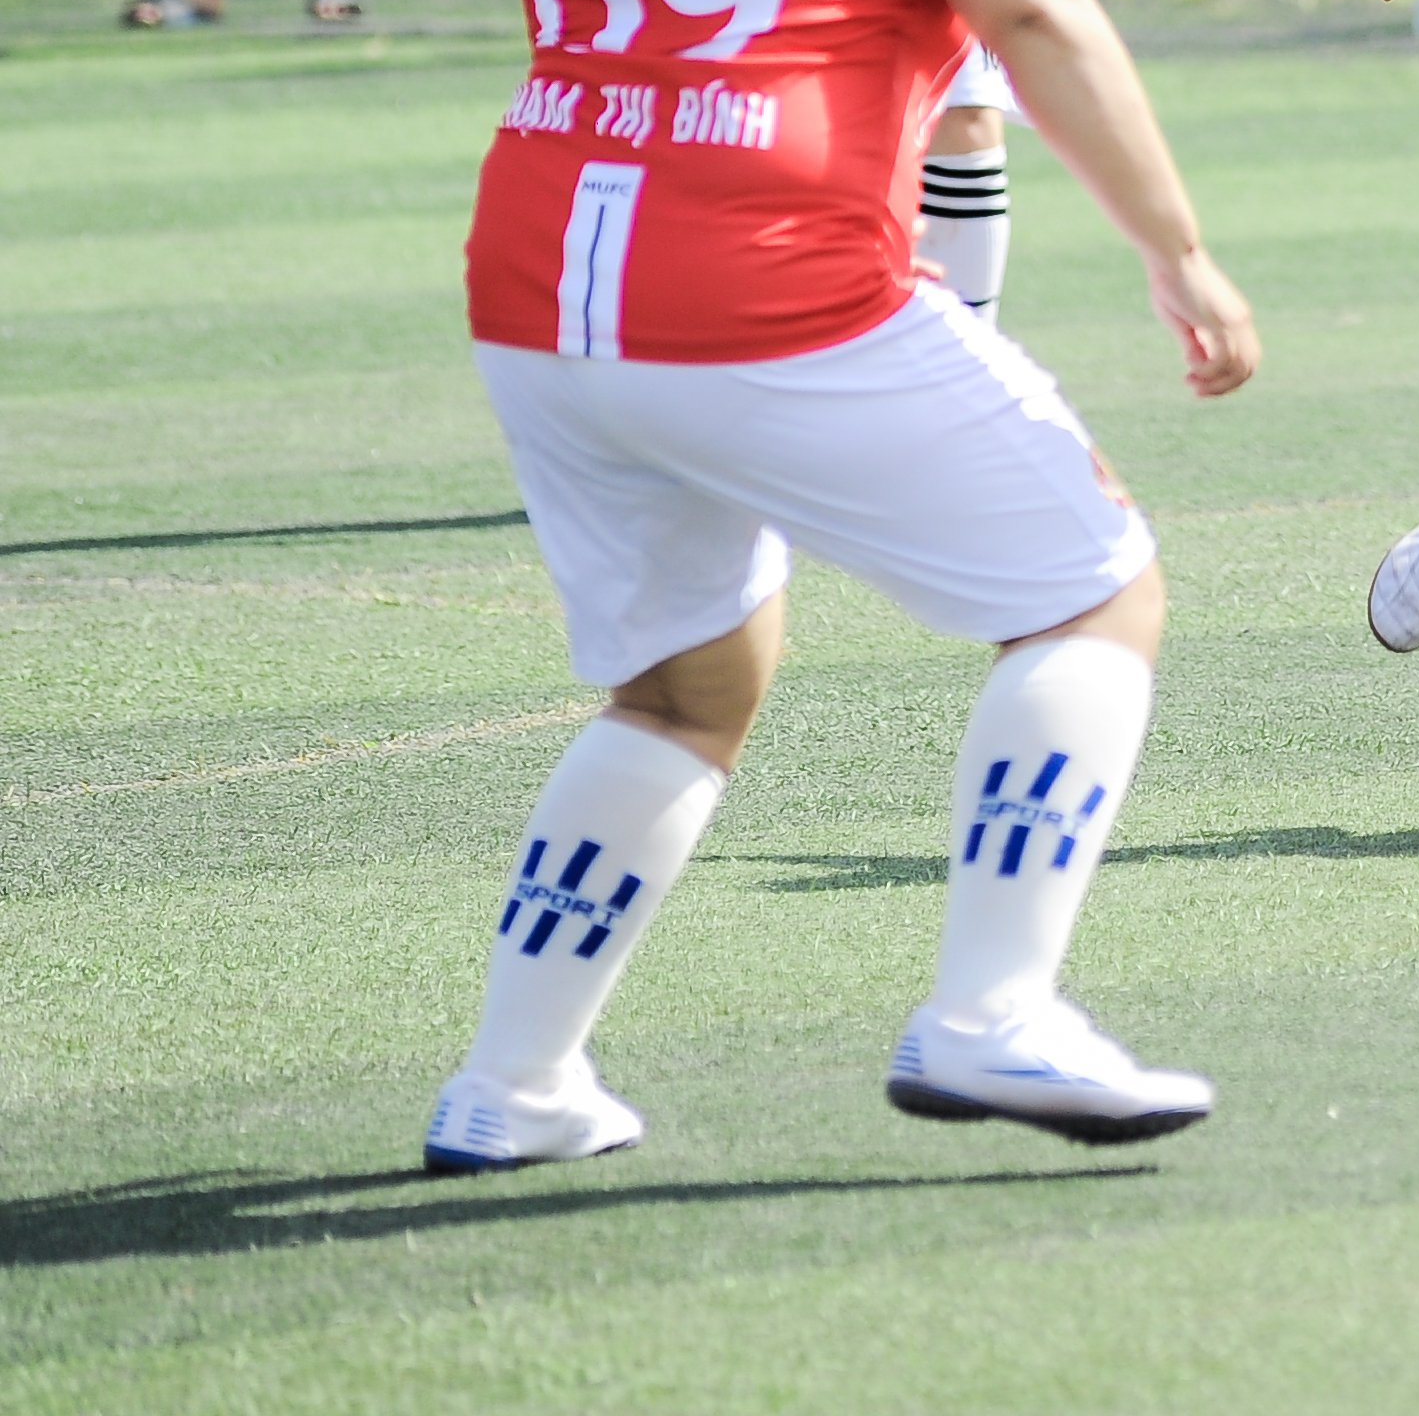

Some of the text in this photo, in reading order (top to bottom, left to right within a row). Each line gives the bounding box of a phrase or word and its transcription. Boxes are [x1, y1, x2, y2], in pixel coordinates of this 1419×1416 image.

[500, 78, 584, 139] HẠM
[596, 85, 657, 149] THỊ
[582, 181, 631, 197] MUFC
